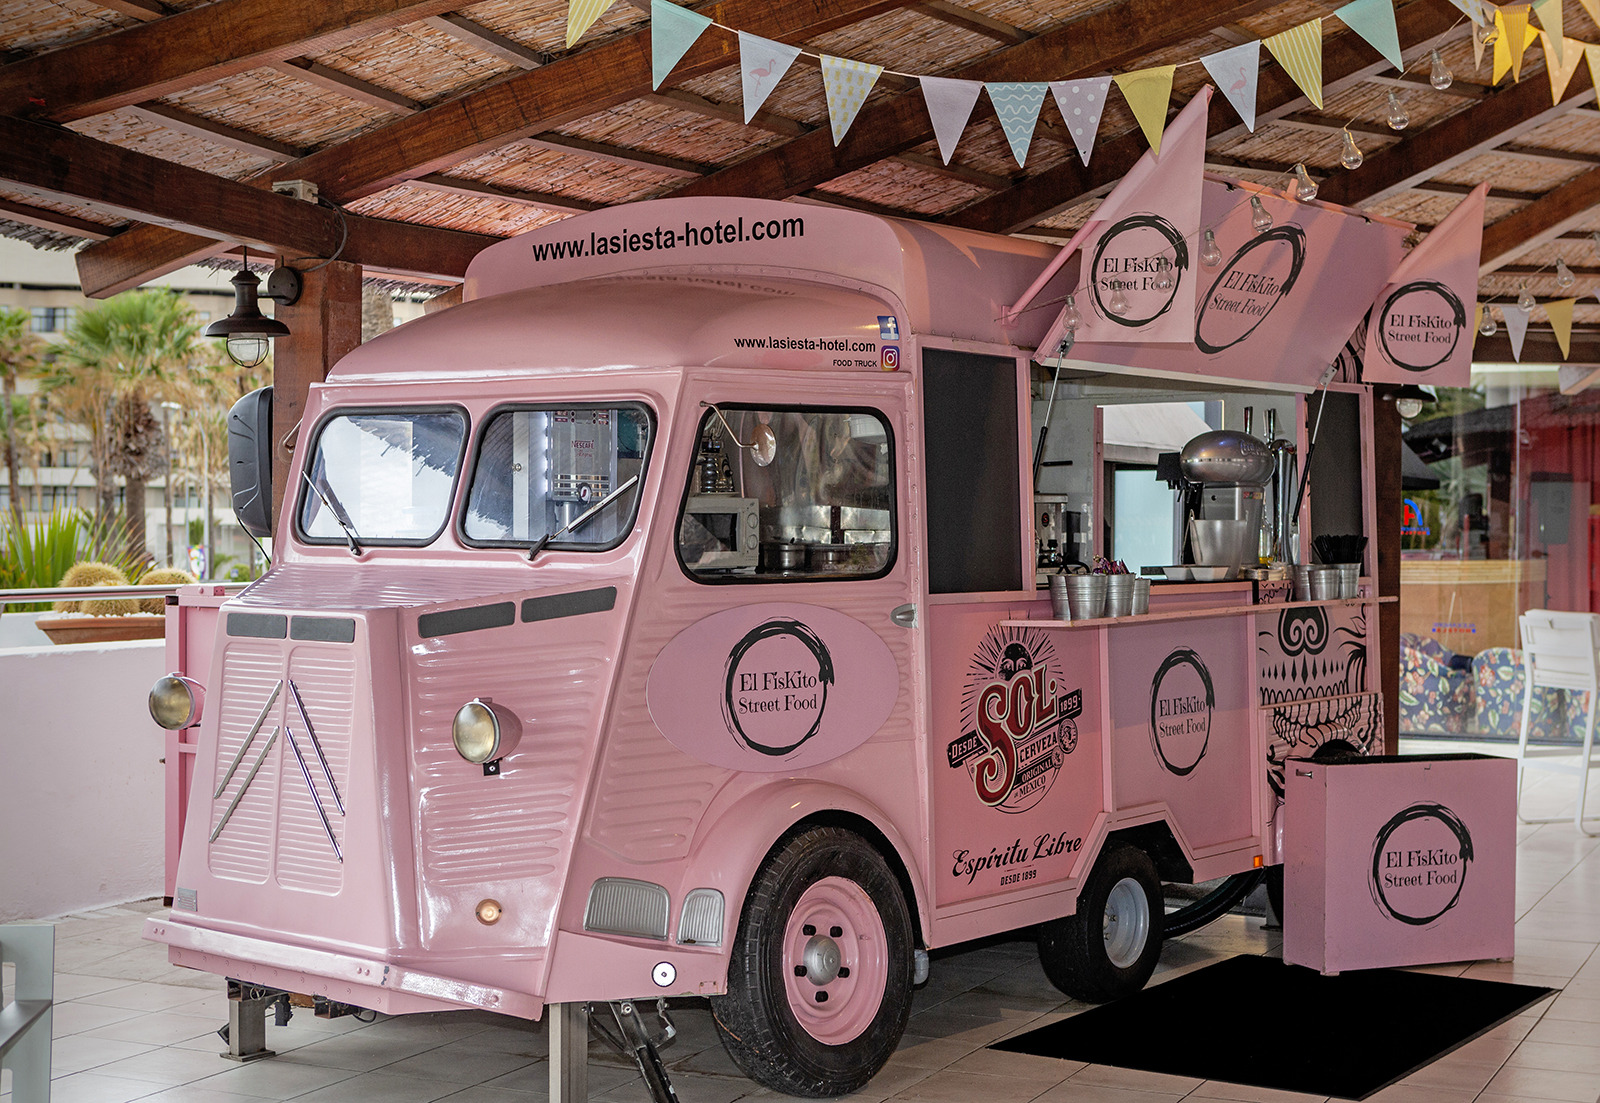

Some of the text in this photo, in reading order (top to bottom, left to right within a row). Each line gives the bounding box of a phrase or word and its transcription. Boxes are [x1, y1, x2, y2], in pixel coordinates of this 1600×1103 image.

[533, 216, 805, 262] www.lasiesta-hotel.com
[1102, 257, 1119, 273] El
[1222, 270, 1280, 296] El FisKito
[1209, 292, 1270, 317] Street Food
[1390, 314, 1452, 329] El FisKito
[734, 336, 876, 352] www.lasiesta-hotel.com
[1388, 329, 1451, 344] Street Food
[832, 359, 878, 368] FOOD TRUCK
[739, 670, 817, 692] El FisKito
[738, 694, 817, 714] Street Food
[1159, 695, 1206, 717] El FisKito
[951, 694, 1078, 760] DESDE 1899
[1159, 717, 1206, 738] Street Food
[1019, 731, 1058, 763] CERVEZA
[1021, 757, 1053, 783] ORIGINAL
[952, 831, 1082, 886] Espíritu Libre
[1385, 848, 1458, 868] El FisKito
[1000, 869, 1037, 886] DESDE 1899
[1384, 869, 1458, 889] Street Food
